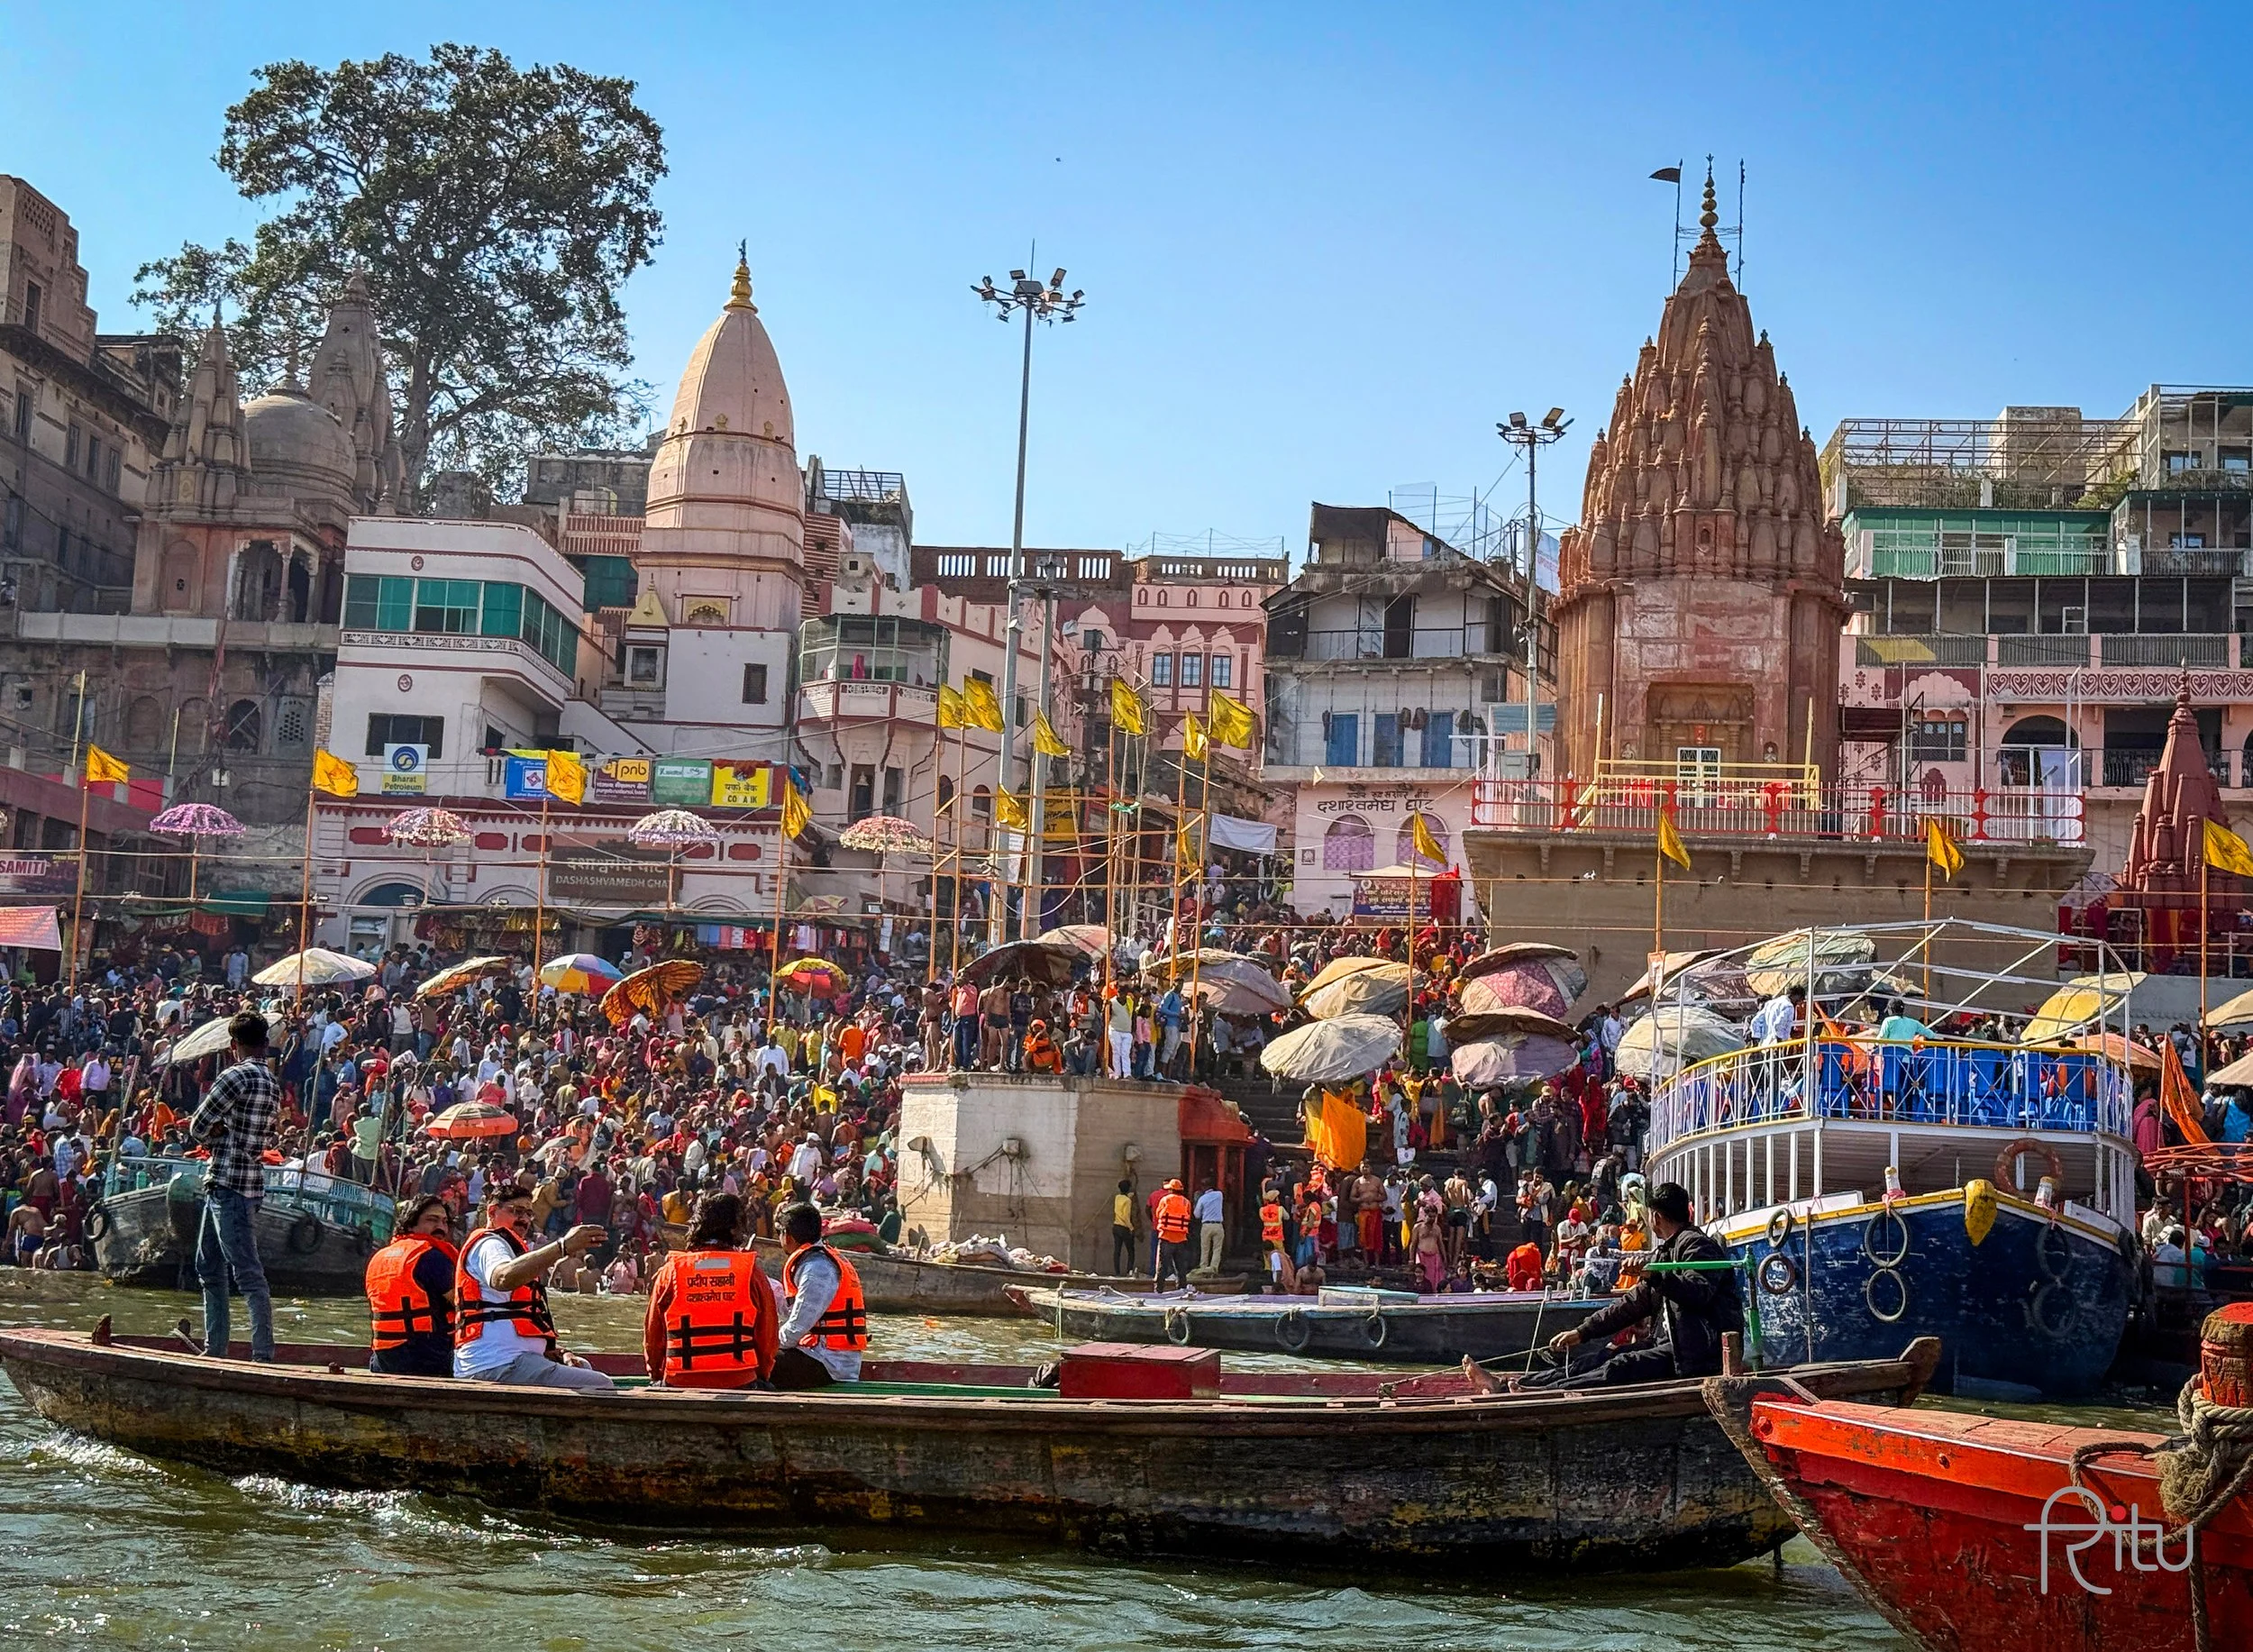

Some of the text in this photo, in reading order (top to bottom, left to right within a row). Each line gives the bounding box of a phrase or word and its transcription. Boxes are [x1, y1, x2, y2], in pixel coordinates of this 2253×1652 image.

[620, 762, 647, 778] pnb
[384, 782, 423, 791] Petroleum
[1318, 798, 1397, 813] दशाश्वमेध
[0, 860, 45, 874] SAMITI
[555, 875, 645, 888] DASHASHVAMEDH
[687, 1273, 708, 1288] प्रदीप
